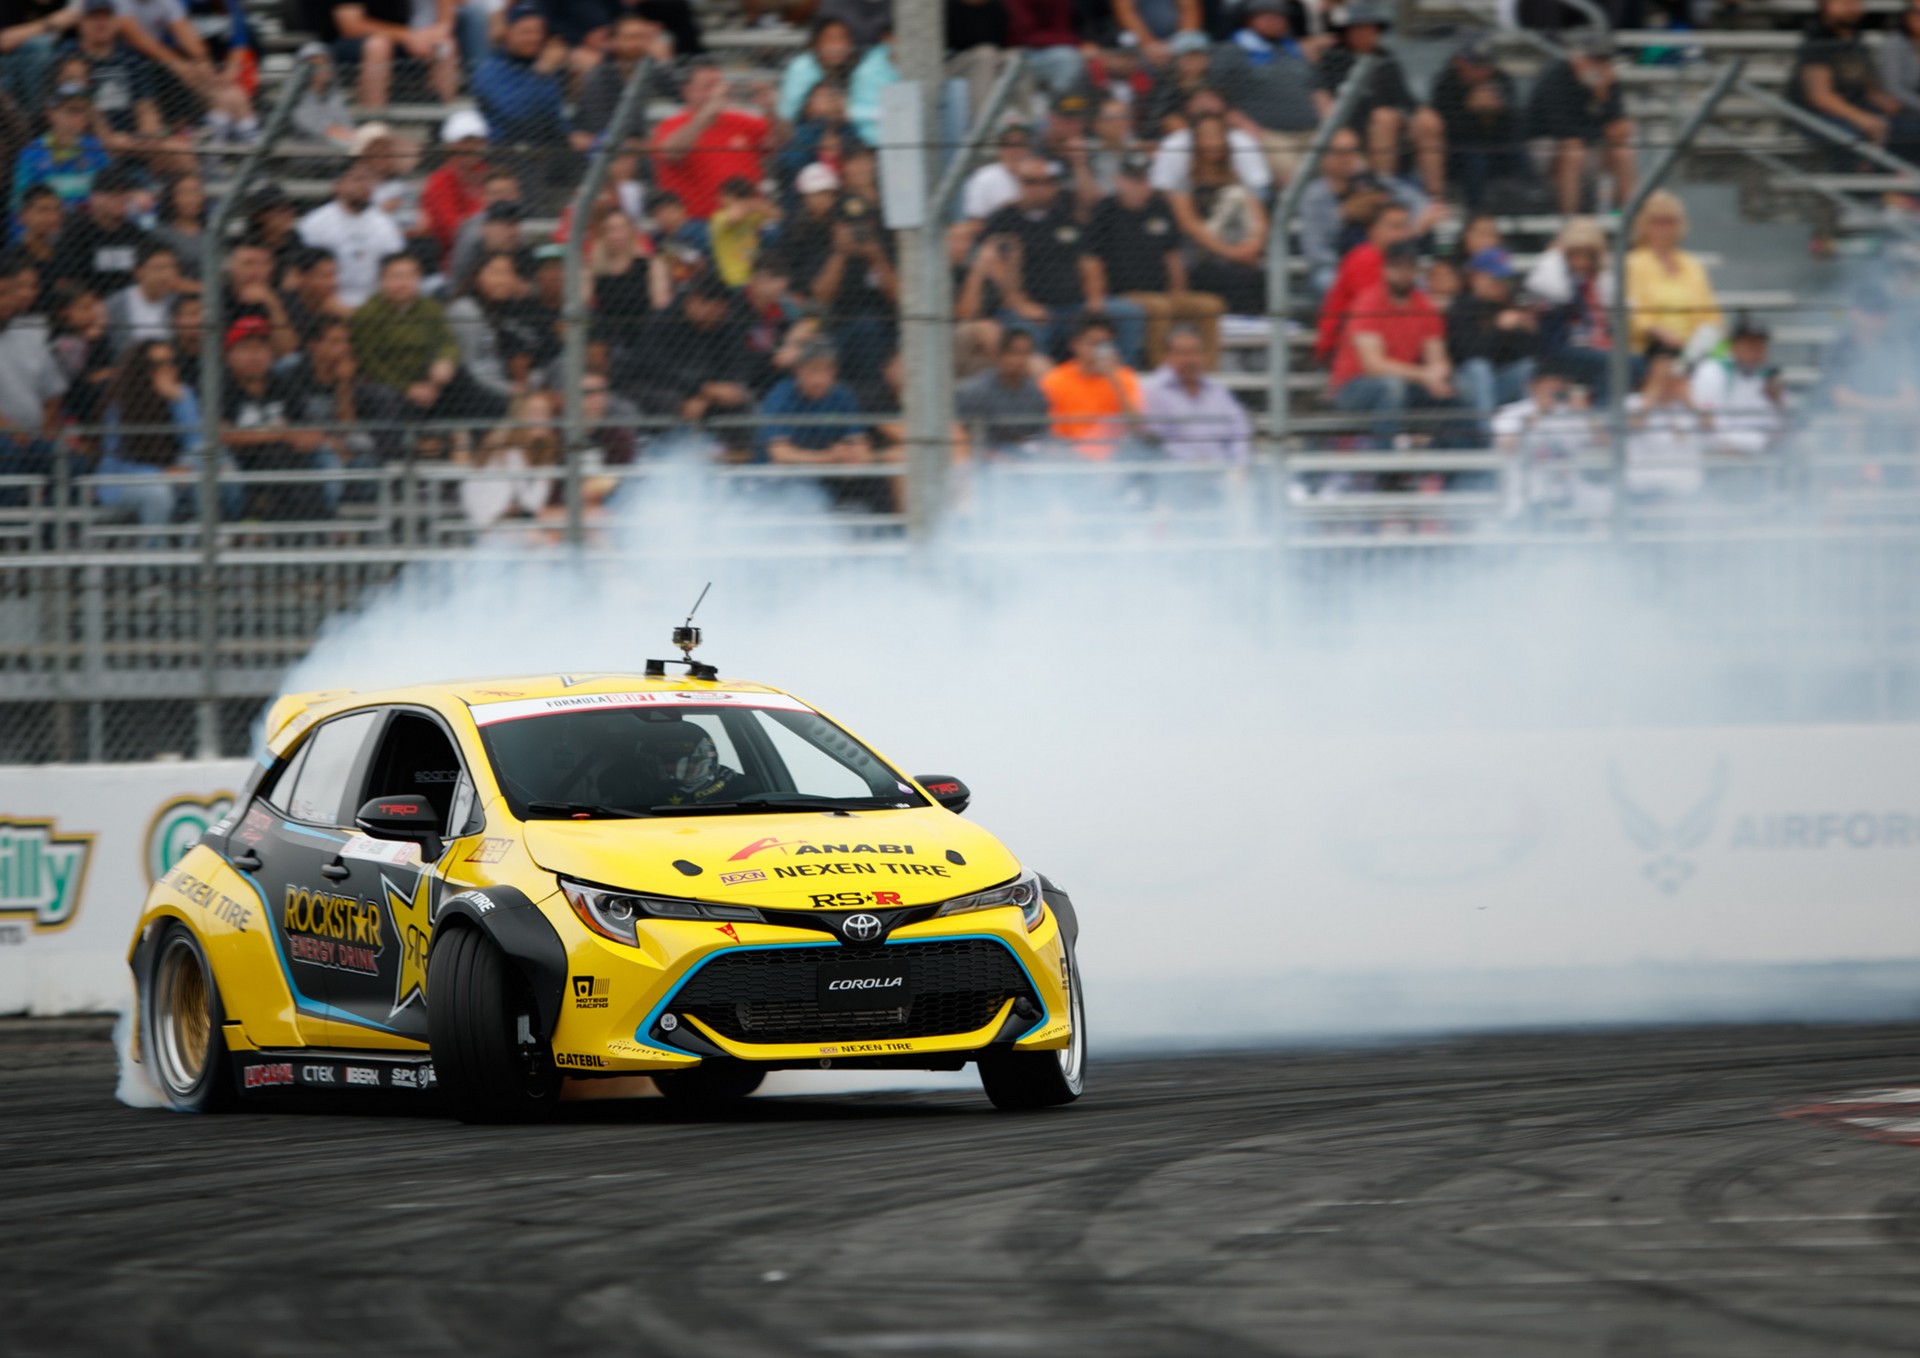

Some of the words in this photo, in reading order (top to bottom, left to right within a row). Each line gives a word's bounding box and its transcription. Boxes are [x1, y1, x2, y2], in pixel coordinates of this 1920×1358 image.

[414, 770, 458, 780] sparc
[927, 782, 959, 795] TRD
[378, 804, 418, 816] TRD
[1729, 811, 1920, 849] AIRFOR
[795, 844, 914, 855] ANABI
[0, 837, 75, 911] illy
[773, 863, 876, 879] NEXEN
[880, 863, 951, 878] TIRE
[213, 895, 252, 933] TIRE
[290, 934, 336, 963] ENERGY
[337, 944, 379, 971] DRINK
[828, 977, 902, 990] COROLLA
[841, 1043, 882, 1053] NEXEN
[884, 1043, 913, 1052] TIRE
[556, 1053, 604, 1067] GATEBIL
[302, 1065, 335, 1082] CTEK
